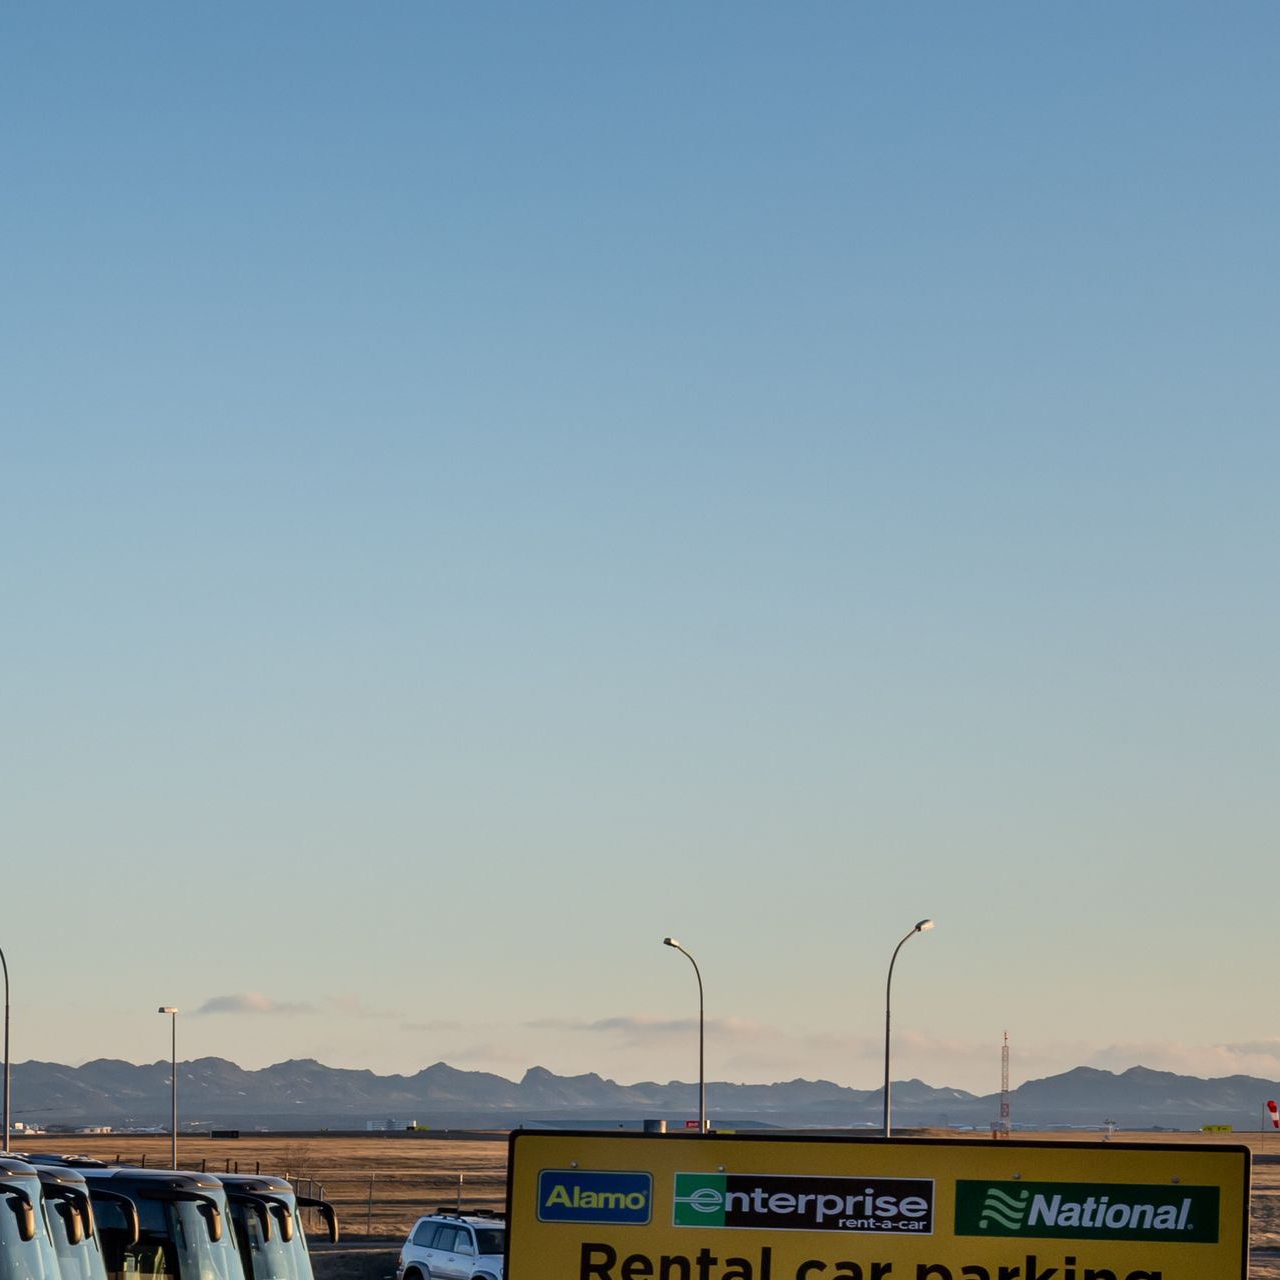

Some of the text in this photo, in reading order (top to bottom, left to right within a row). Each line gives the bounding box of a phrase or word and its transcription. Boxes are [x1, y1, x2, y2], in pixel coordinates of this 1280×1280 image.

[545, 1185, 645, 1210] Alamo
[690, 1188, 929, 1223] enterprise
[1027, 1194, 1192, 1231] National
[839, 1218, 927, 1230] rent-a-car
